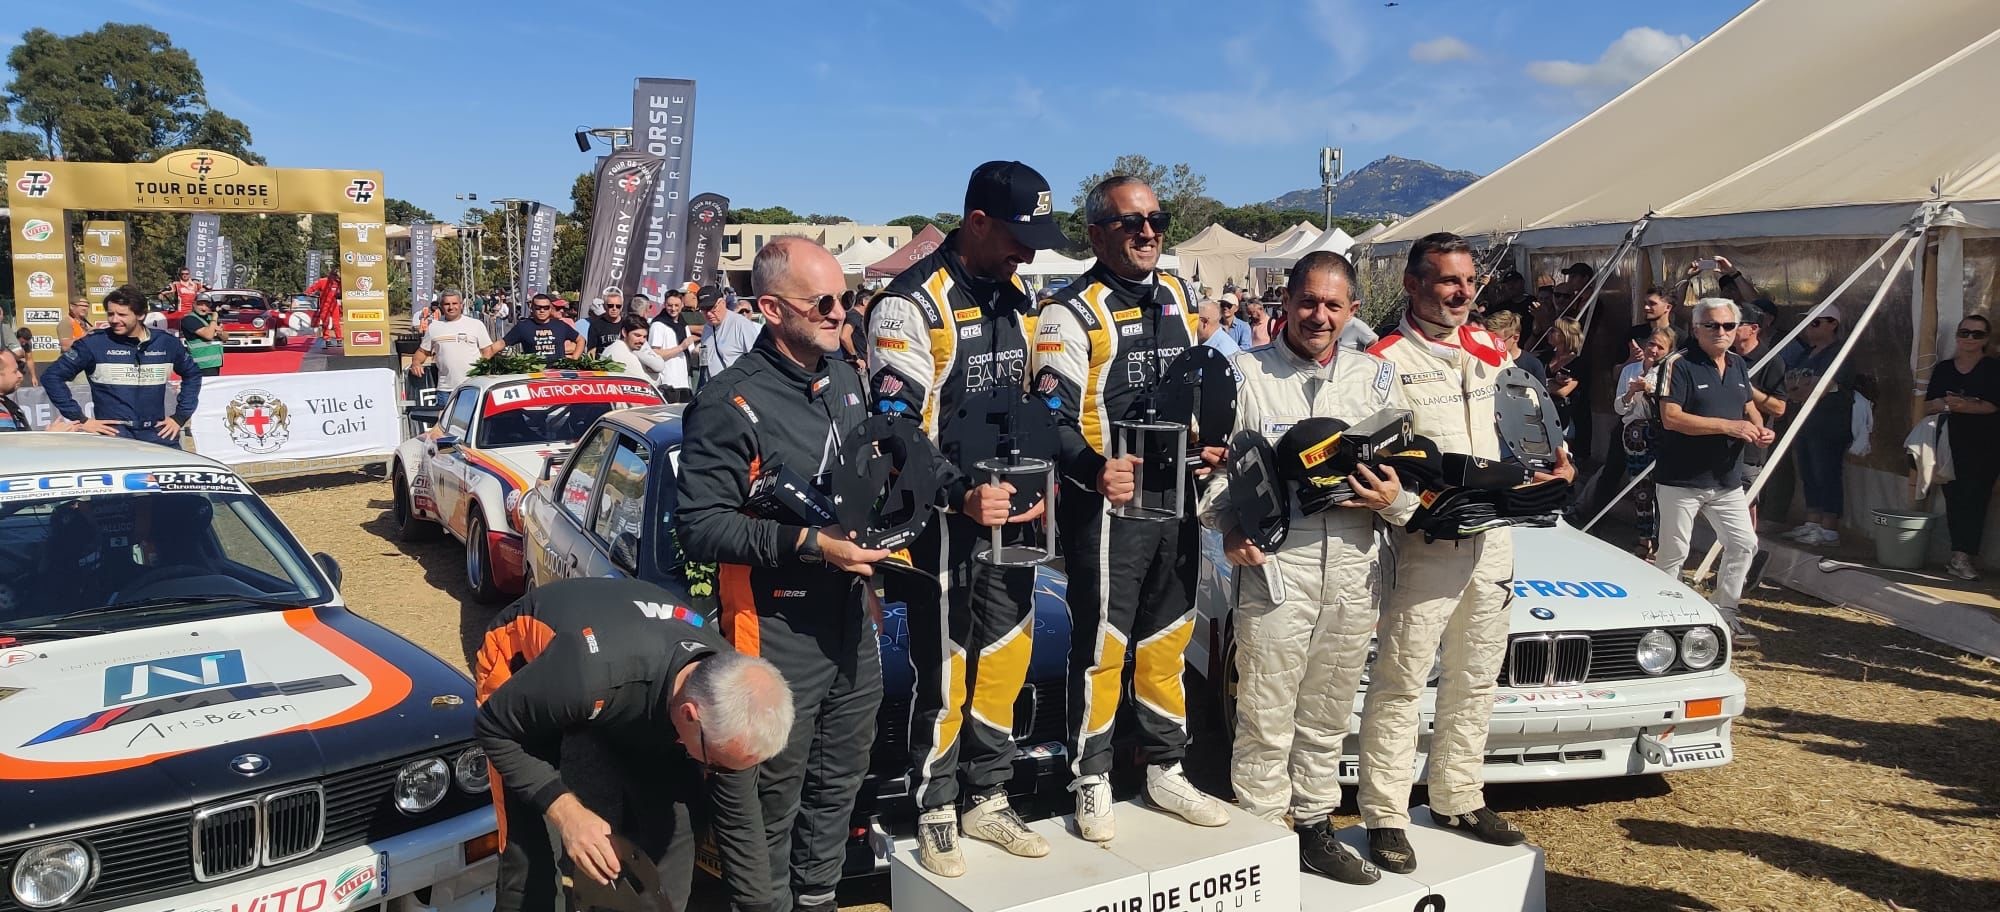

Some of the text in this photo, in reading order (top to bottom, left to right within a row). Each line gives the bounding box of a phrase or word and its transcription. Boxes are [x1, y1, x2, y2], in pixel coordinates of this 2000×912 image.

[648, 95, 669, 168] ORSE
[135, 182, 268, 196] TOUR DE CORSE
[663, 96, 684, 273] HISTORIQUE
[137, 196, 269, 206] HISTORIQUE
[197, 220, 208, 253] CORSE
[611, 211, 631, 280] CHERRY
[416, 229, 424, 290] TOUR DE CORSE
[692, 234, 708, 281] CHERRY
[1412, 371, 1444, 381] ZENITH
[503, 389, 520, 400] 41
[530, 383, 623, 399] METROPOLITAN
[305, 394, 374, 415] Ville de
[322, 416, 366, 436] Calvi
[8, 653, 25, 666] E
[1152, 887, 1181, 912] DE
[1190, 864, 1261, 904] CORSE
